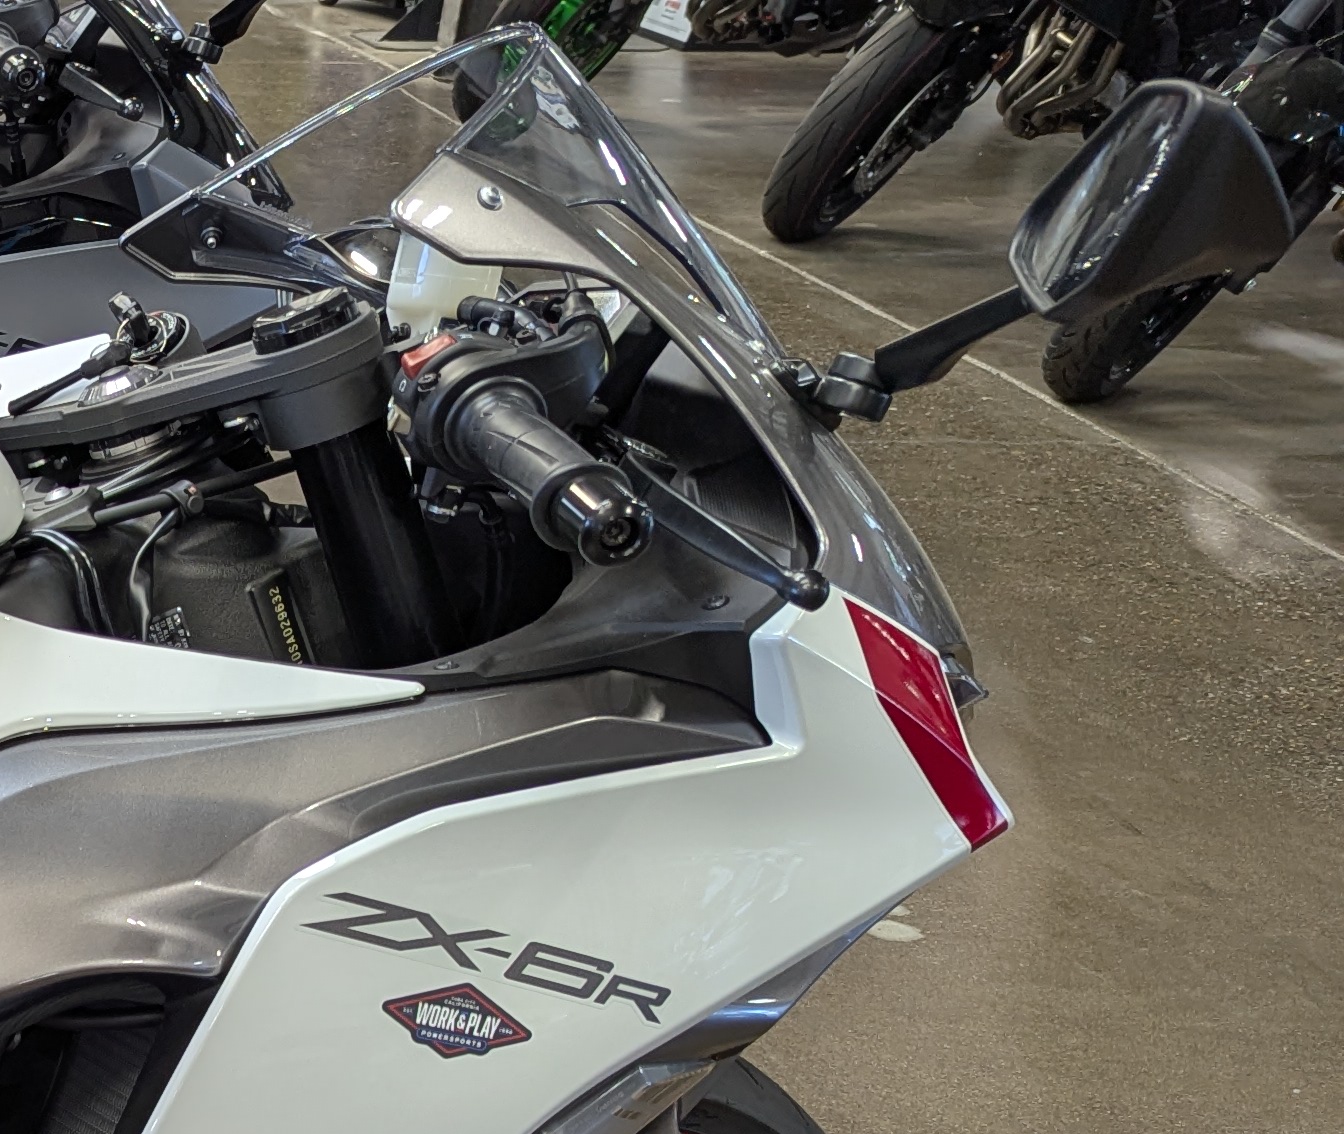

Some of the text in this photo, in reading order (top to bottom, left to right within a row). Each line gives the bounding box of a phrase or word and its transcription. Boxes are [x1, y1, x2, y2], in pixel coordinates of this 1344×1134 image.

[298, 892, 672, 1025] ZX-6R
[416, 1002, 460, 1032] WORK
[464, 1013, 502, 1040] PLAY
[420, 1030, 483, 1049] POWERSPORTS
